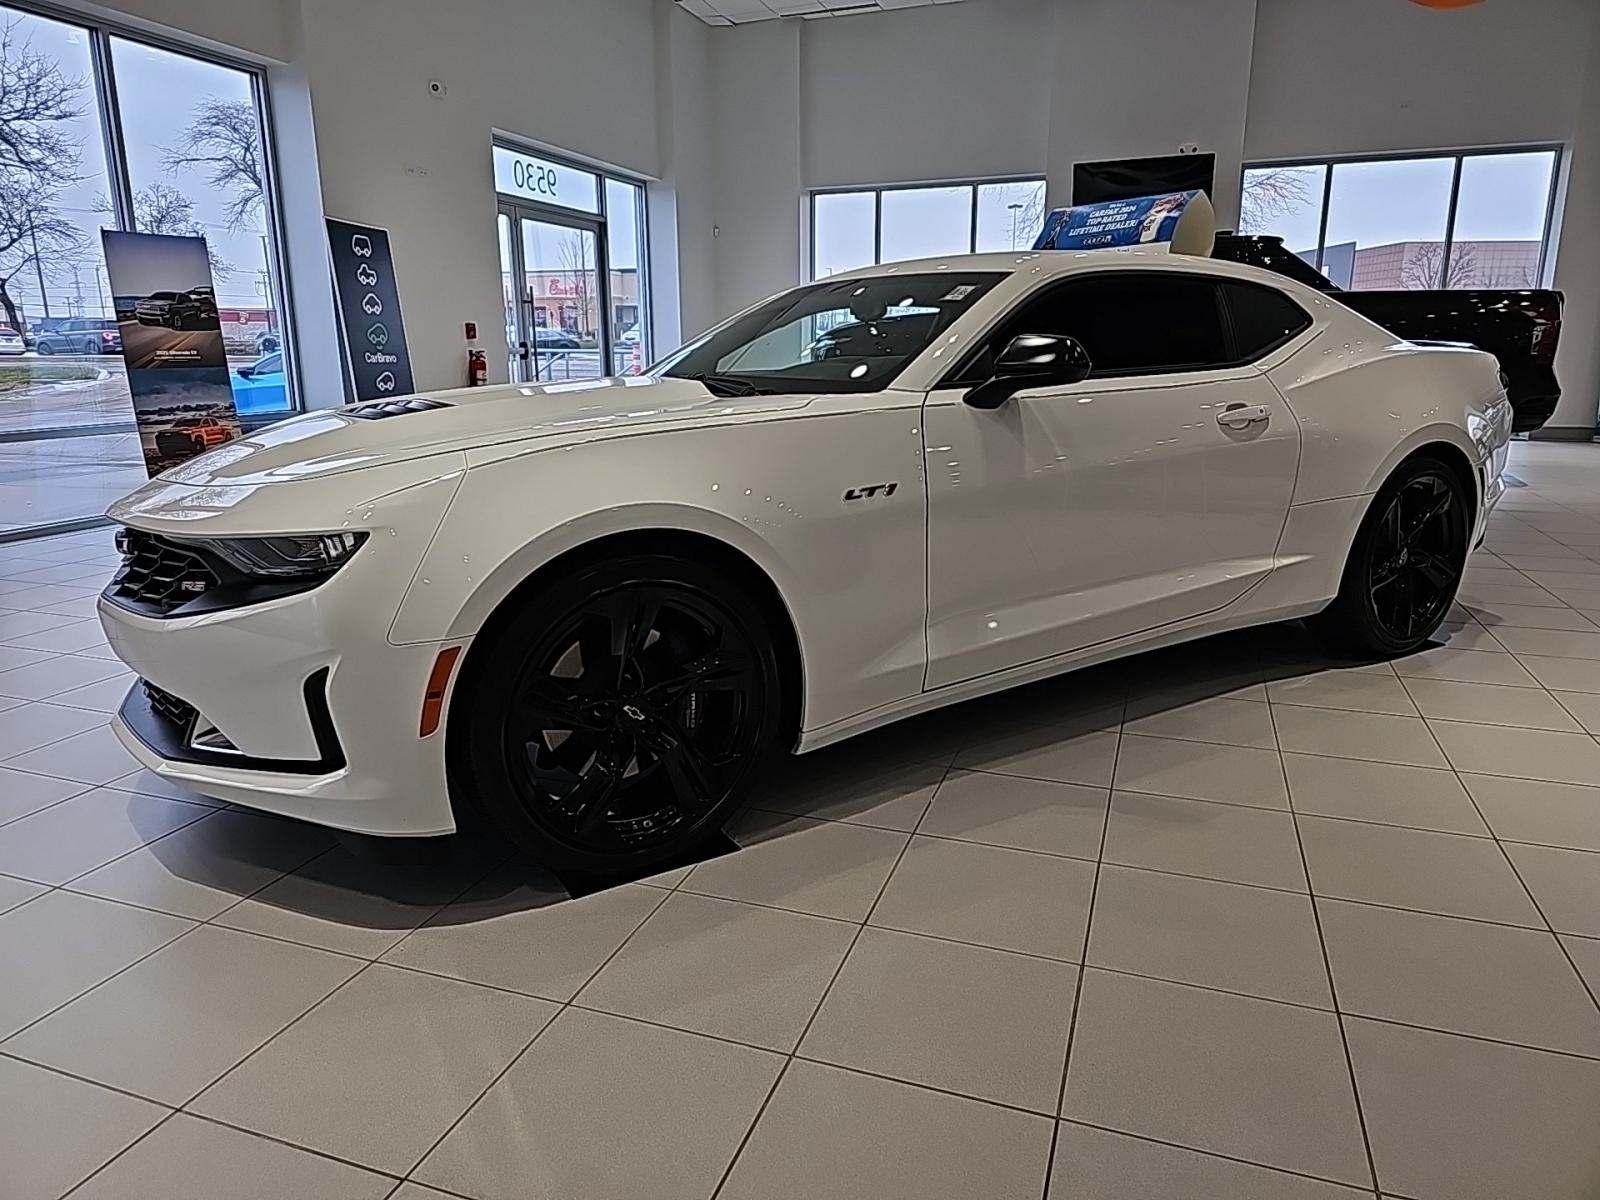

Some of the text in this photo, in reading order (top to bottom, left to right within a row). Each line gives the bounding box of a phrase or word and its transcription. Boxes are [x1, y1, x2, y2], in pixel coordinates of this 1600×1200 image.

[1089, 208, 1120, 218] CARFAX
[1068, 224, 1105, 237] LIFETIME
[1104, 219, 1139, 231] DEALER!
[364, 352, 397, 364] CarBravo
[844, 482, 898, 502] LT1
[181, 581, 206, 592] RS
